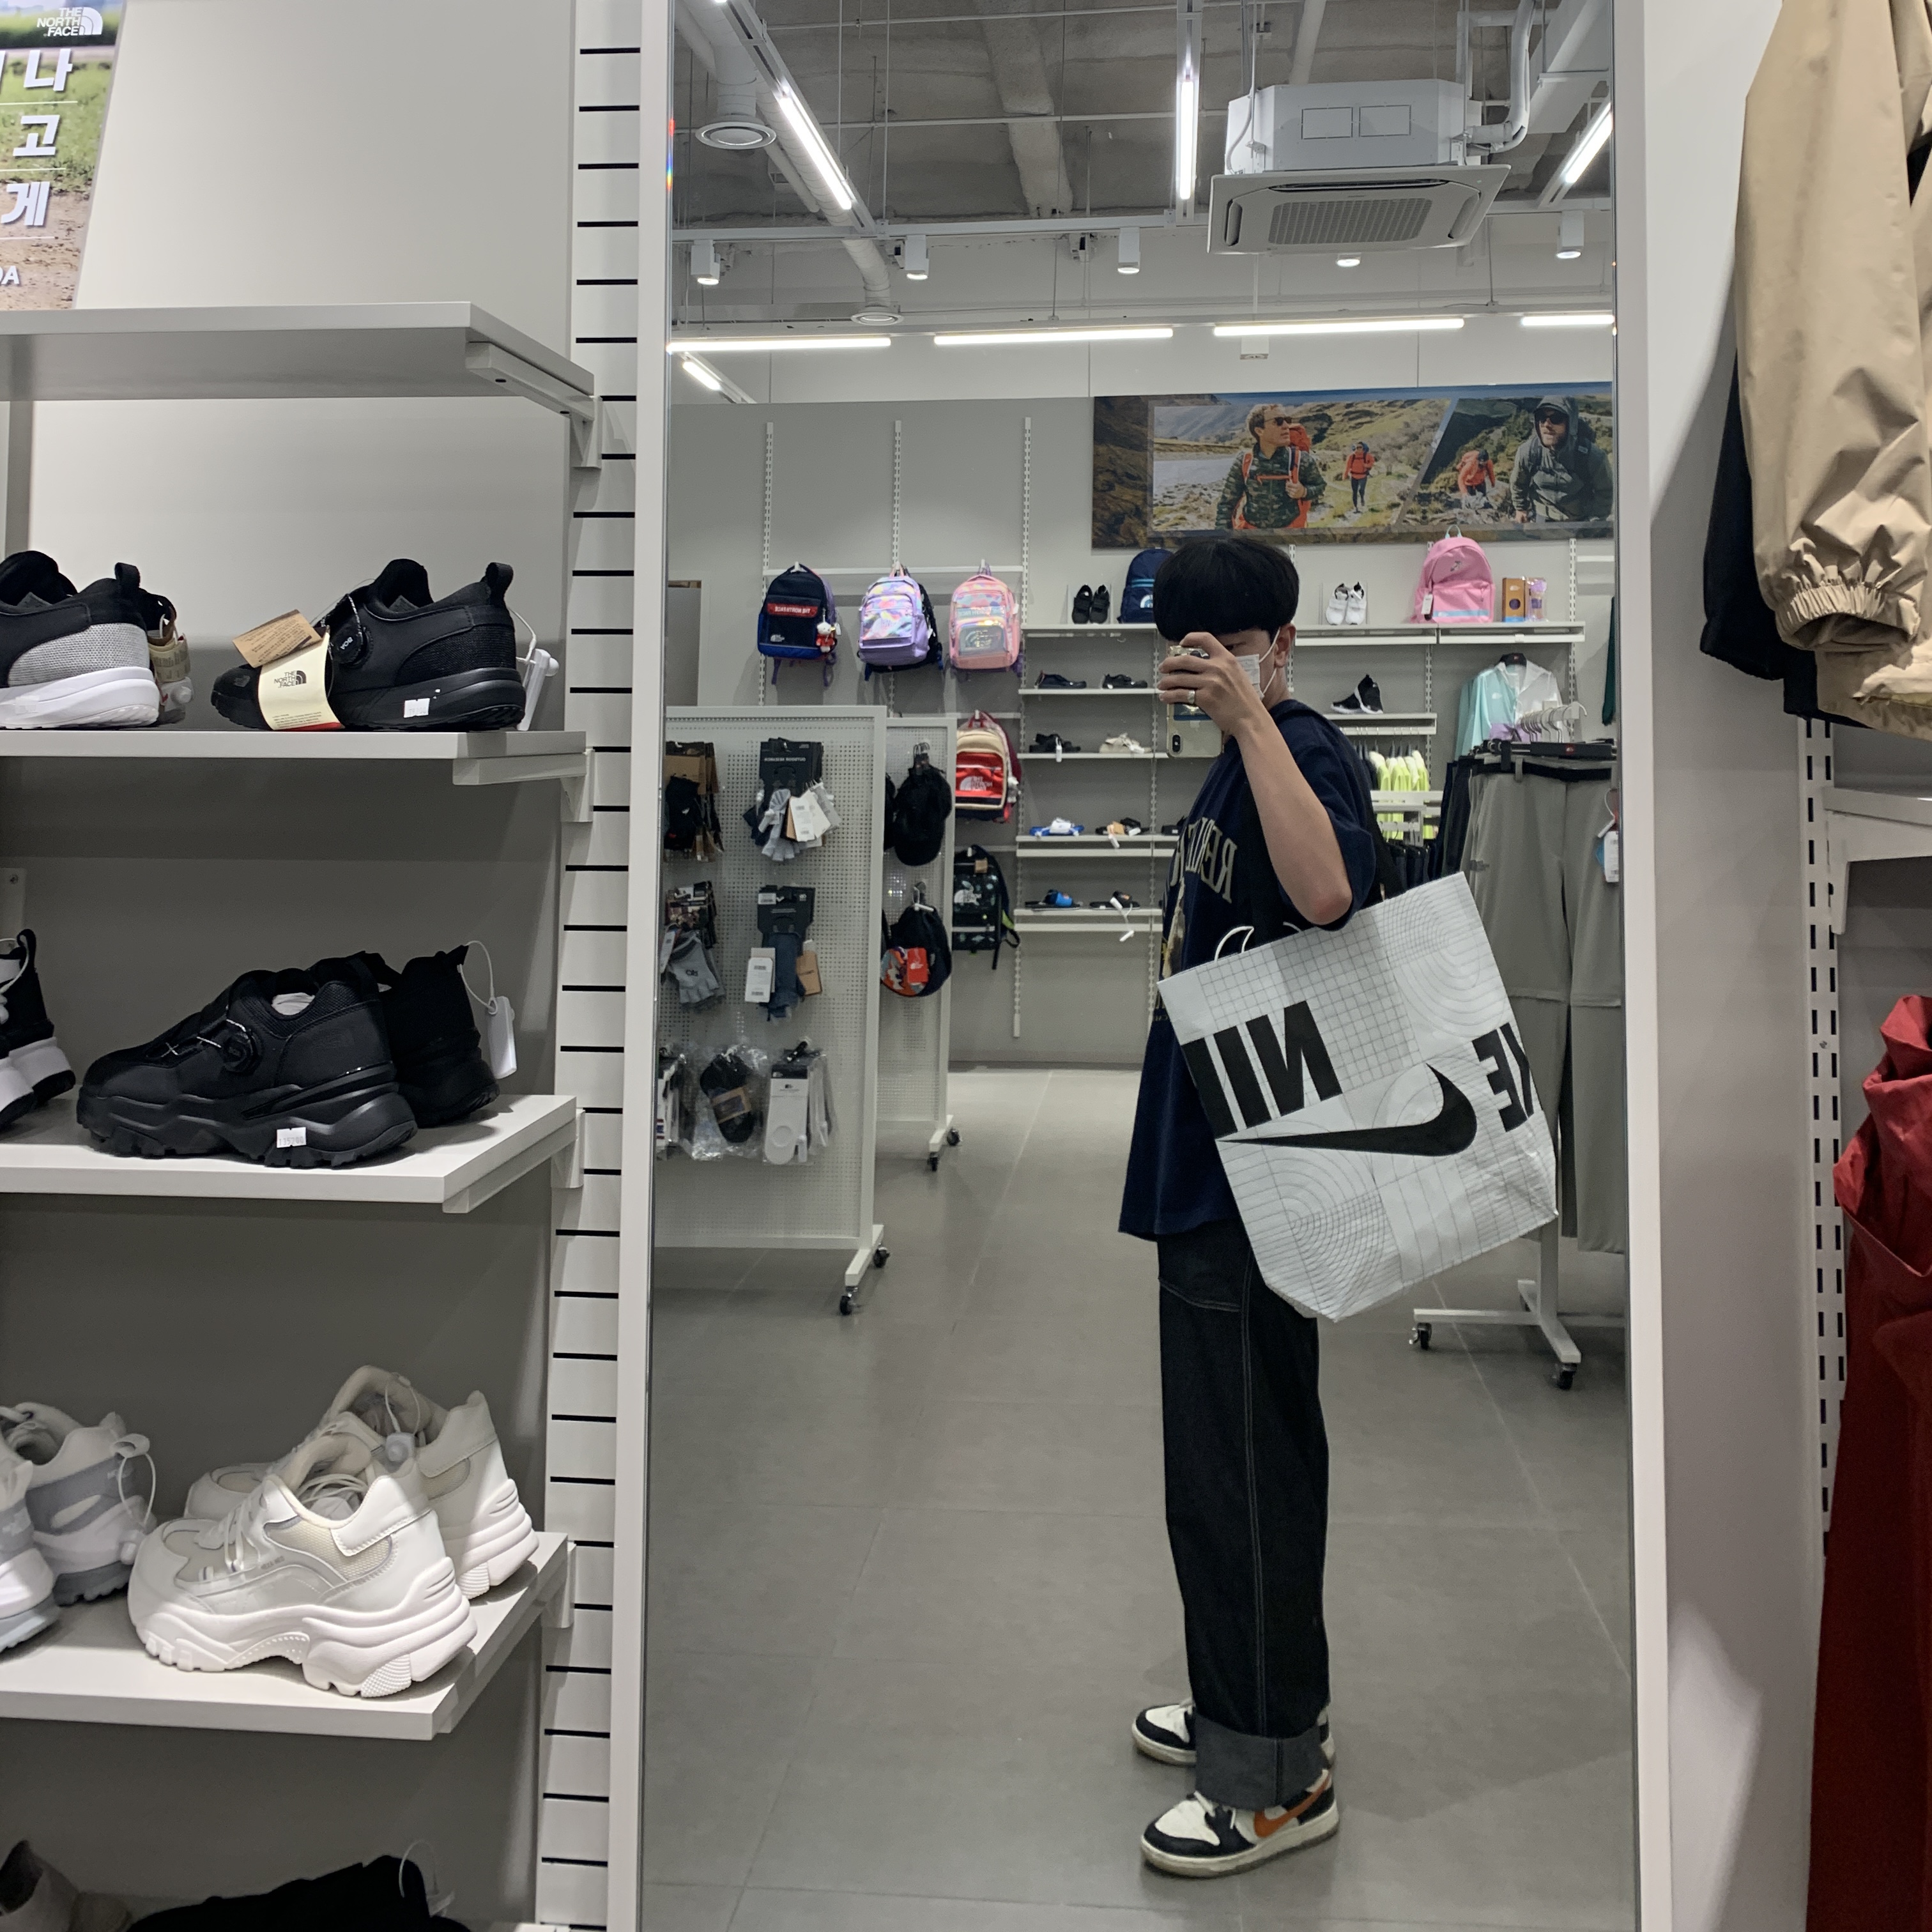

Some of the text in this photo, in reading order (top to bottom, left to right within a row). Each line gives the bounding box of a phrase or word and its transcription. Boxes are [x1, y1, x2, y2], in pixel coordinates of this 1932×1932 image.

[59, 6, 83, 17] THE
[36, 17, 81, 27] NORTH
[47, 26, 79, 36] FACE
[0, 49, 73, 91] 나
[13, 114, 61, 157] 고
[0, 181, 50, 226] 게
[0, 265, 20, 284] A
[340, 636, 353, 650] BOA
[279, 1137, 304, 1146] 135200
